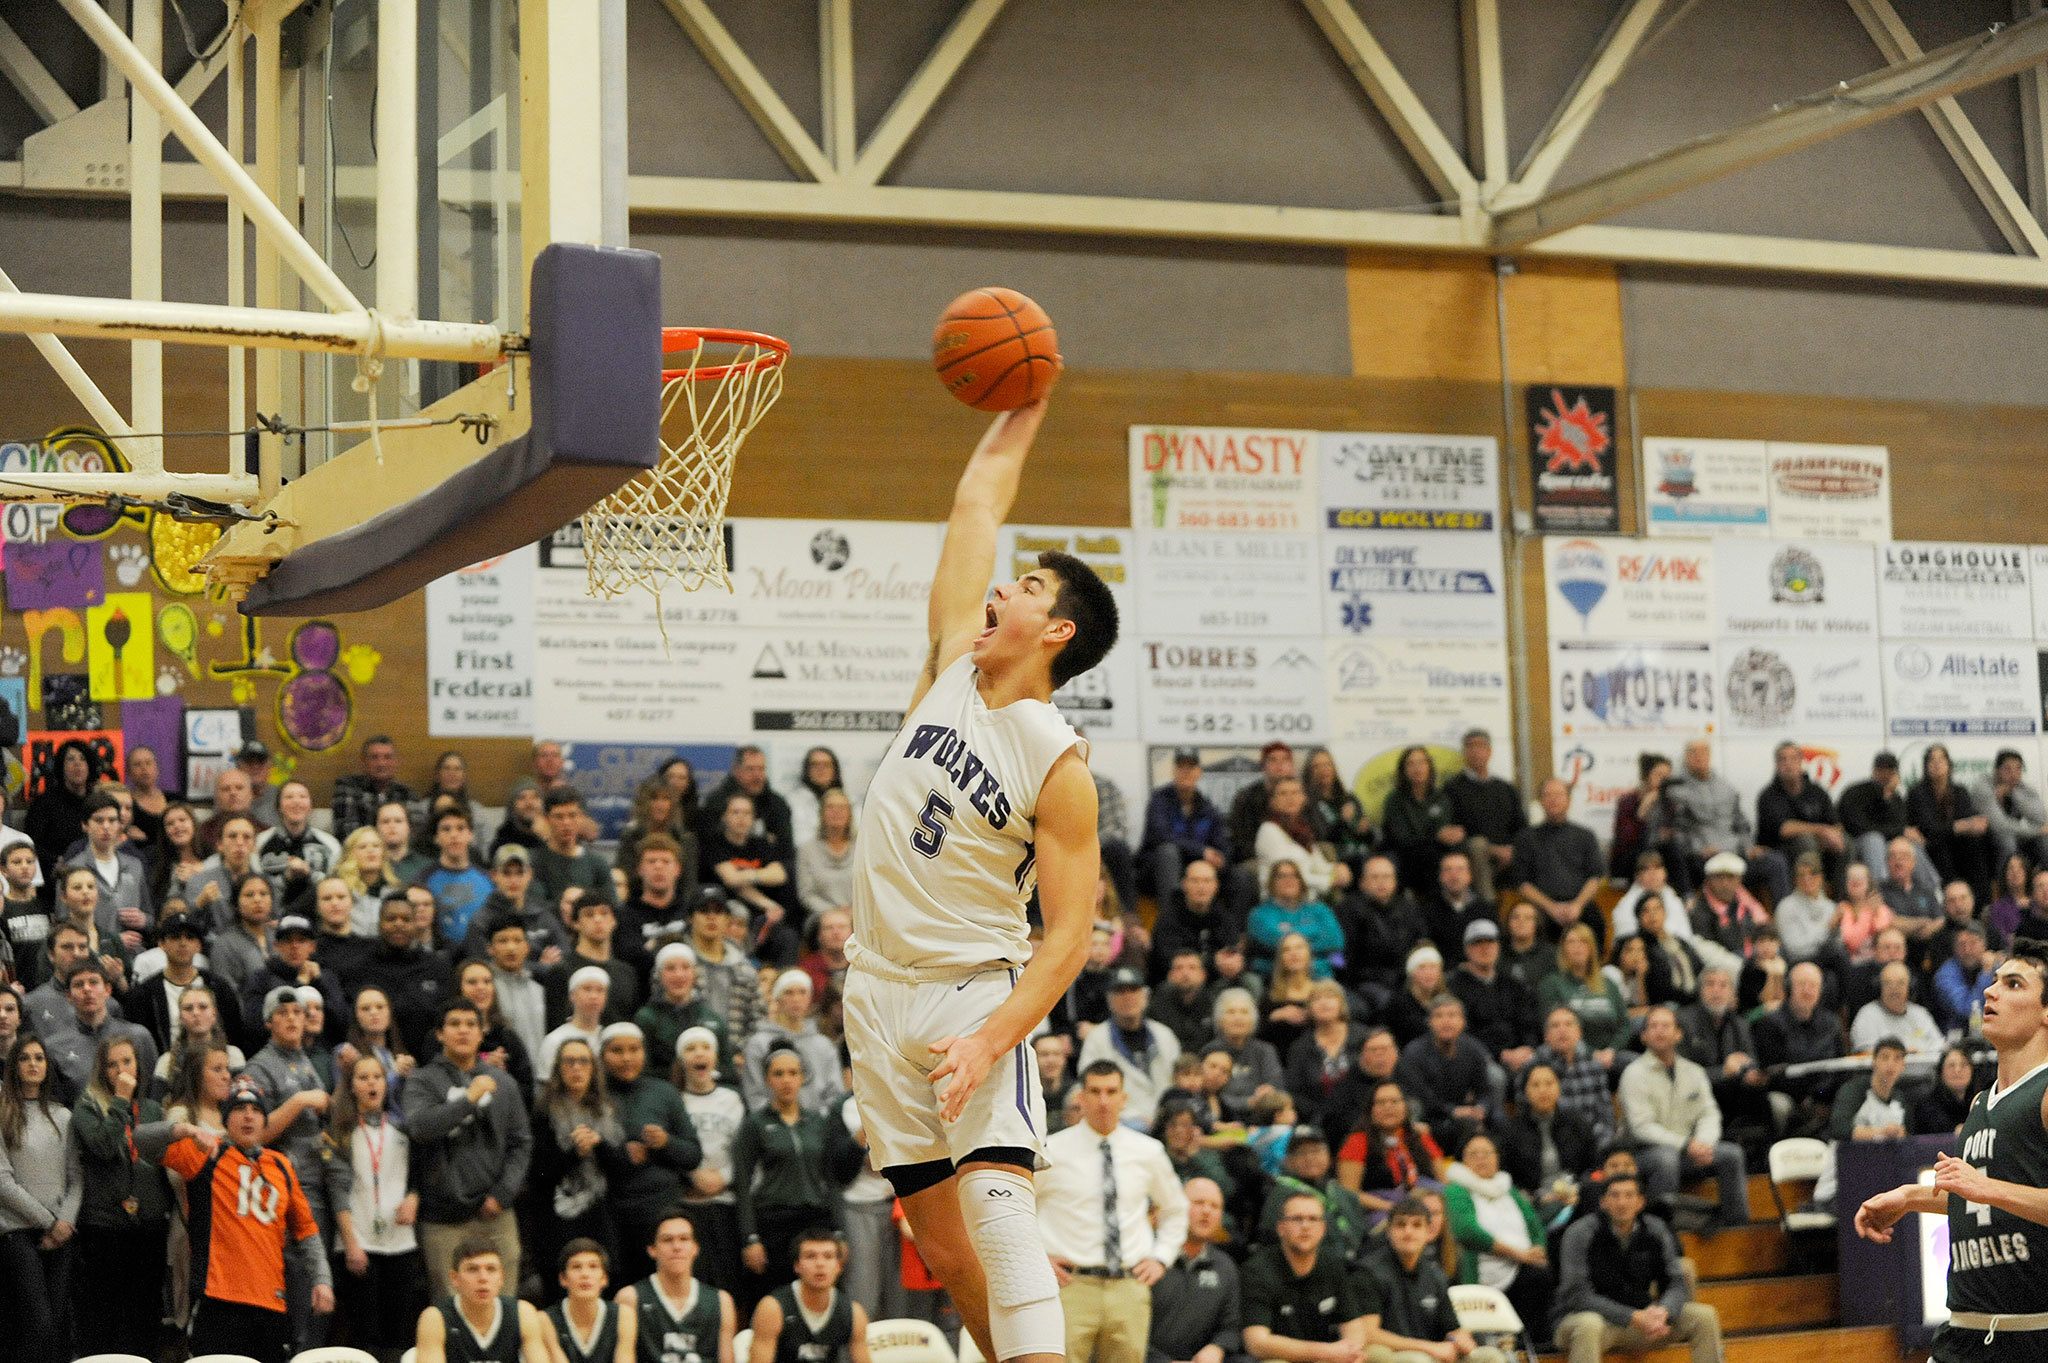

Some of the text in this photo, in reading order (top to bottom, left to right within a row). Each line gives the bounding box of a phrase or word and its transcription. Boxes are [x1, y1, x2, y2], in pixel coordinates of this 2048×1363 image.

[1142, 432, 1307, 475] DYNASTY
[1369, 445, 1486, 466] ANYTIME
[1368, 465, 1487, 485] FITNESS
[5, 503, 63, 544] OF
[1337, 510, 1376, 528] GO
[1335, 545, 1418, 566] OLYMPIC
[1617, 555, 1702, 582] RE/MAX
[1886, 549, 2021, 569] LONGHOUSE
[749, 564, 833, 601] Moon
[456, 650, 515, 669] First
[1939, 653, 2020, 678] Allstate
[432, 679, 532, 698] Federal
[1607, 667, 1715, 714] WOLVES
[903, 723, 1012, 831] WOLVES
[910, 788, 955, 860] 5
[1961, 1128, 1998, 1163] PORT
[236, 1163, 280, 1225] 10
